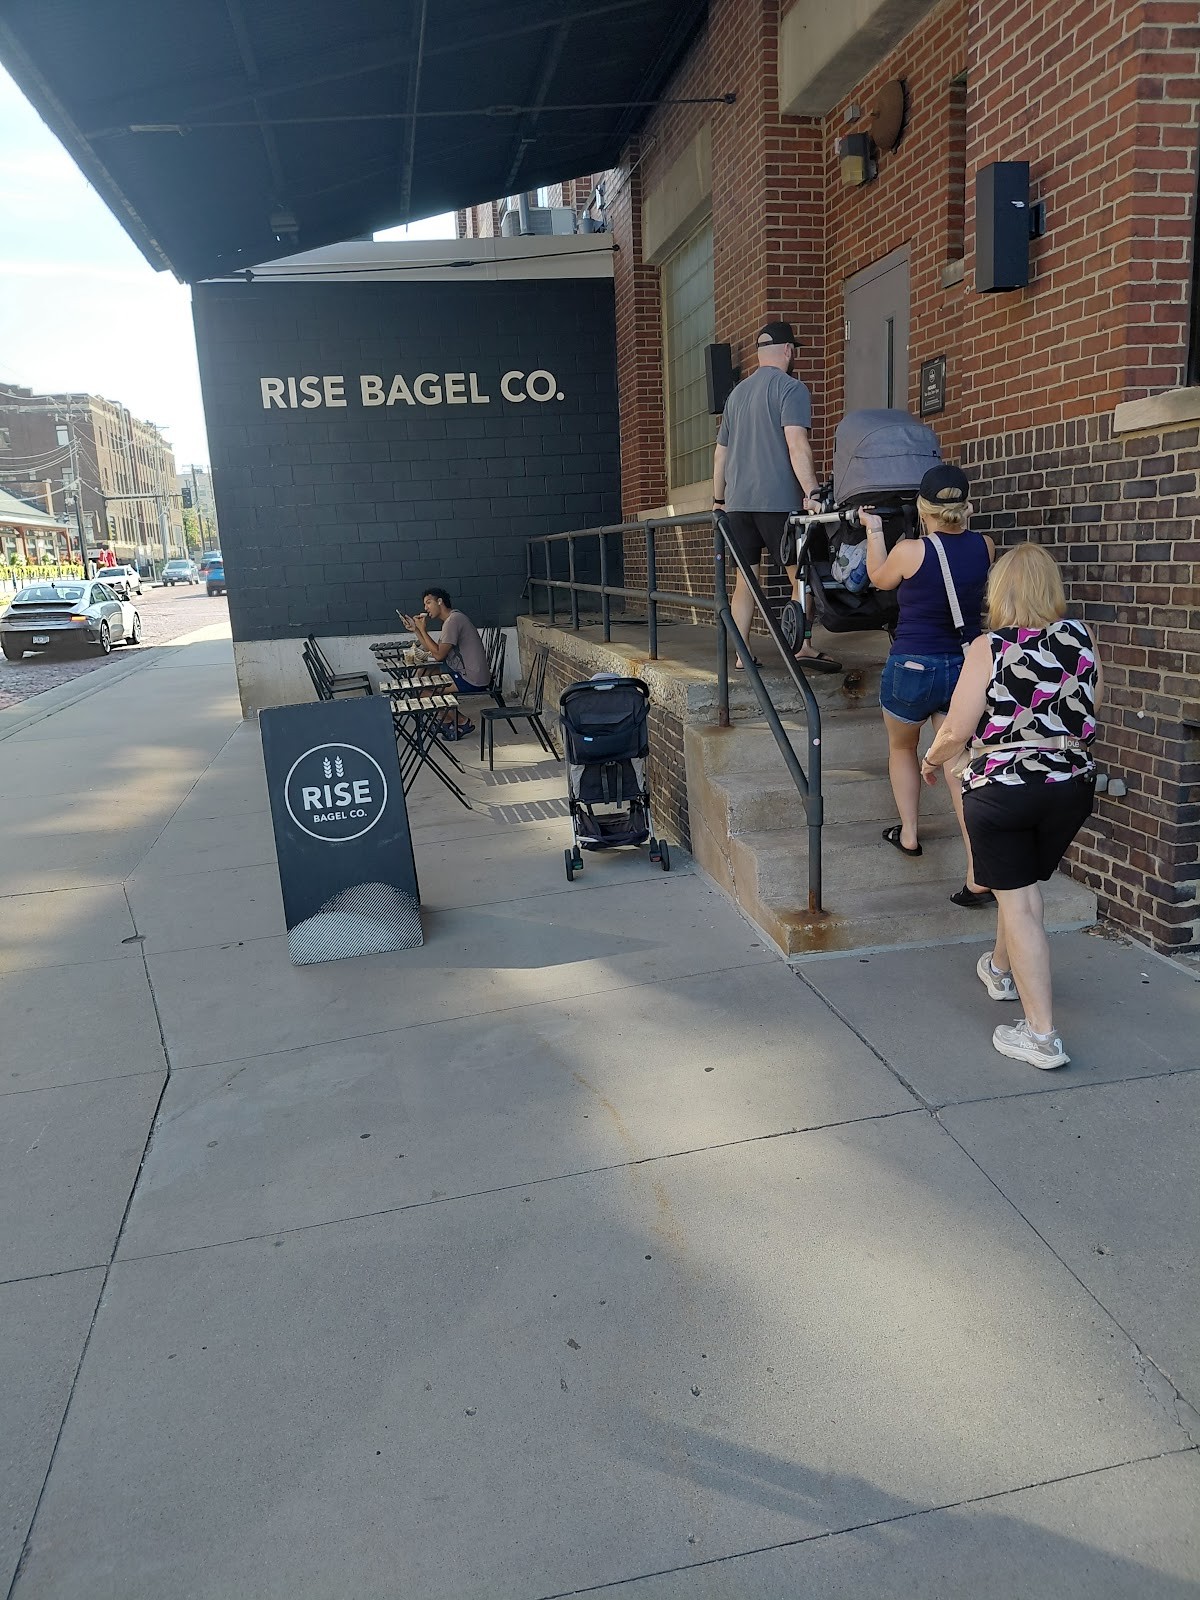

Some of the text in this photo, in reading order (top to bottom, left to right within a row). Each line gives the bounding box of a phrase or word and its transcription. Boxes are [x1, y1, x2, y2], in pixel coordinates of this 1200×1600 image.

[260, 370, 565, 409] RISE BAGEL CO.
[302, 780, 373, 811] RISE
[313, 809, 368, 823] BAGEL CO.
